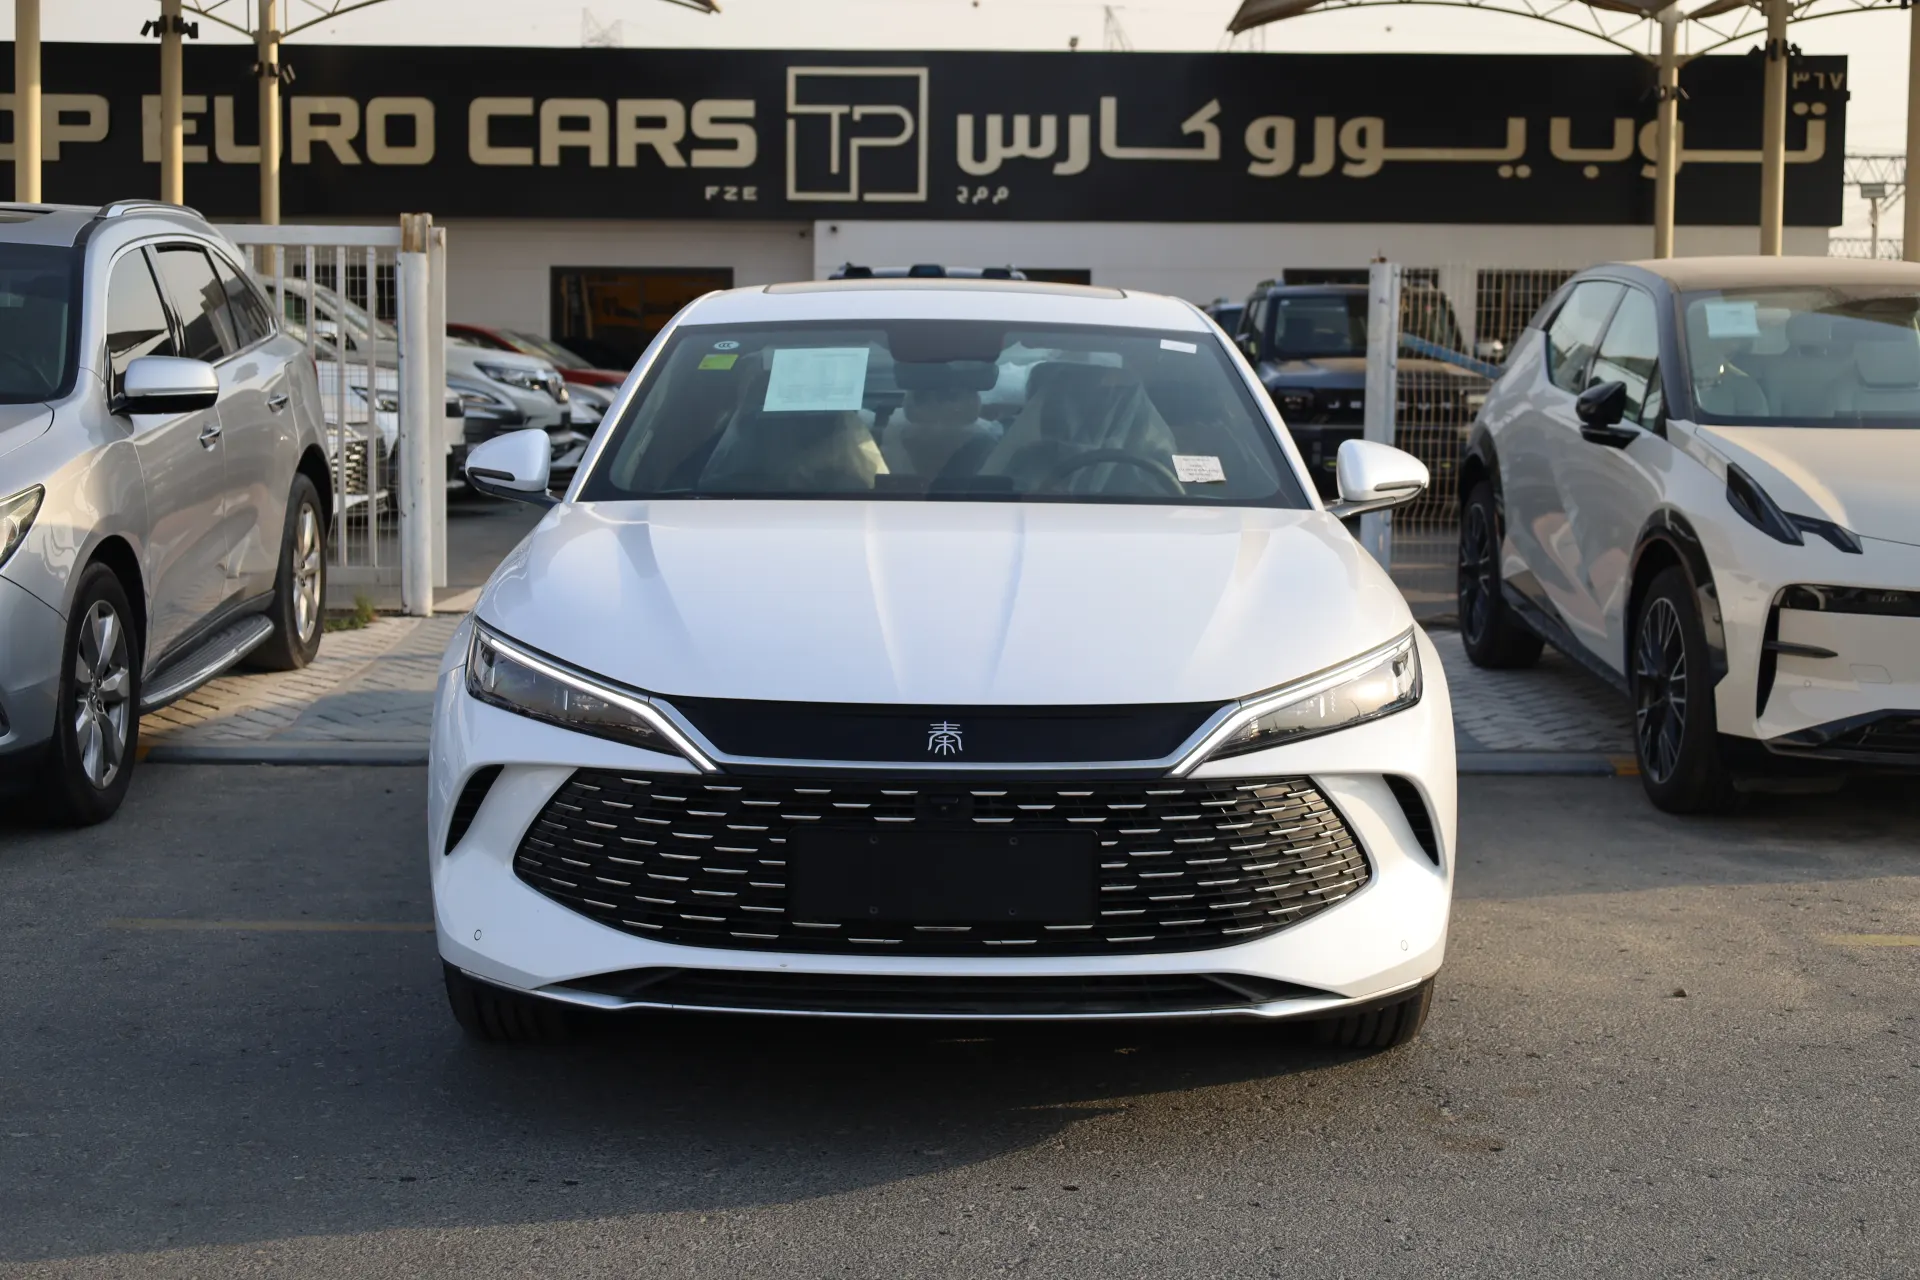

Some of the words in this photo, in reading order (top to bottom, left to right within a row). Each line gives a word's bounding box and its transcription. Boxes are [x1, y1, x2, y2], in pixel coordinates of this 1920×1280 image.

[142, 94, 436, 165] EURO
[468, 96, 758, 168] CARS
[957, 96, 1222, 176] كارس
[1243, 115, 1531, 179] يورو
[704, 186, 758, 201] FZE
